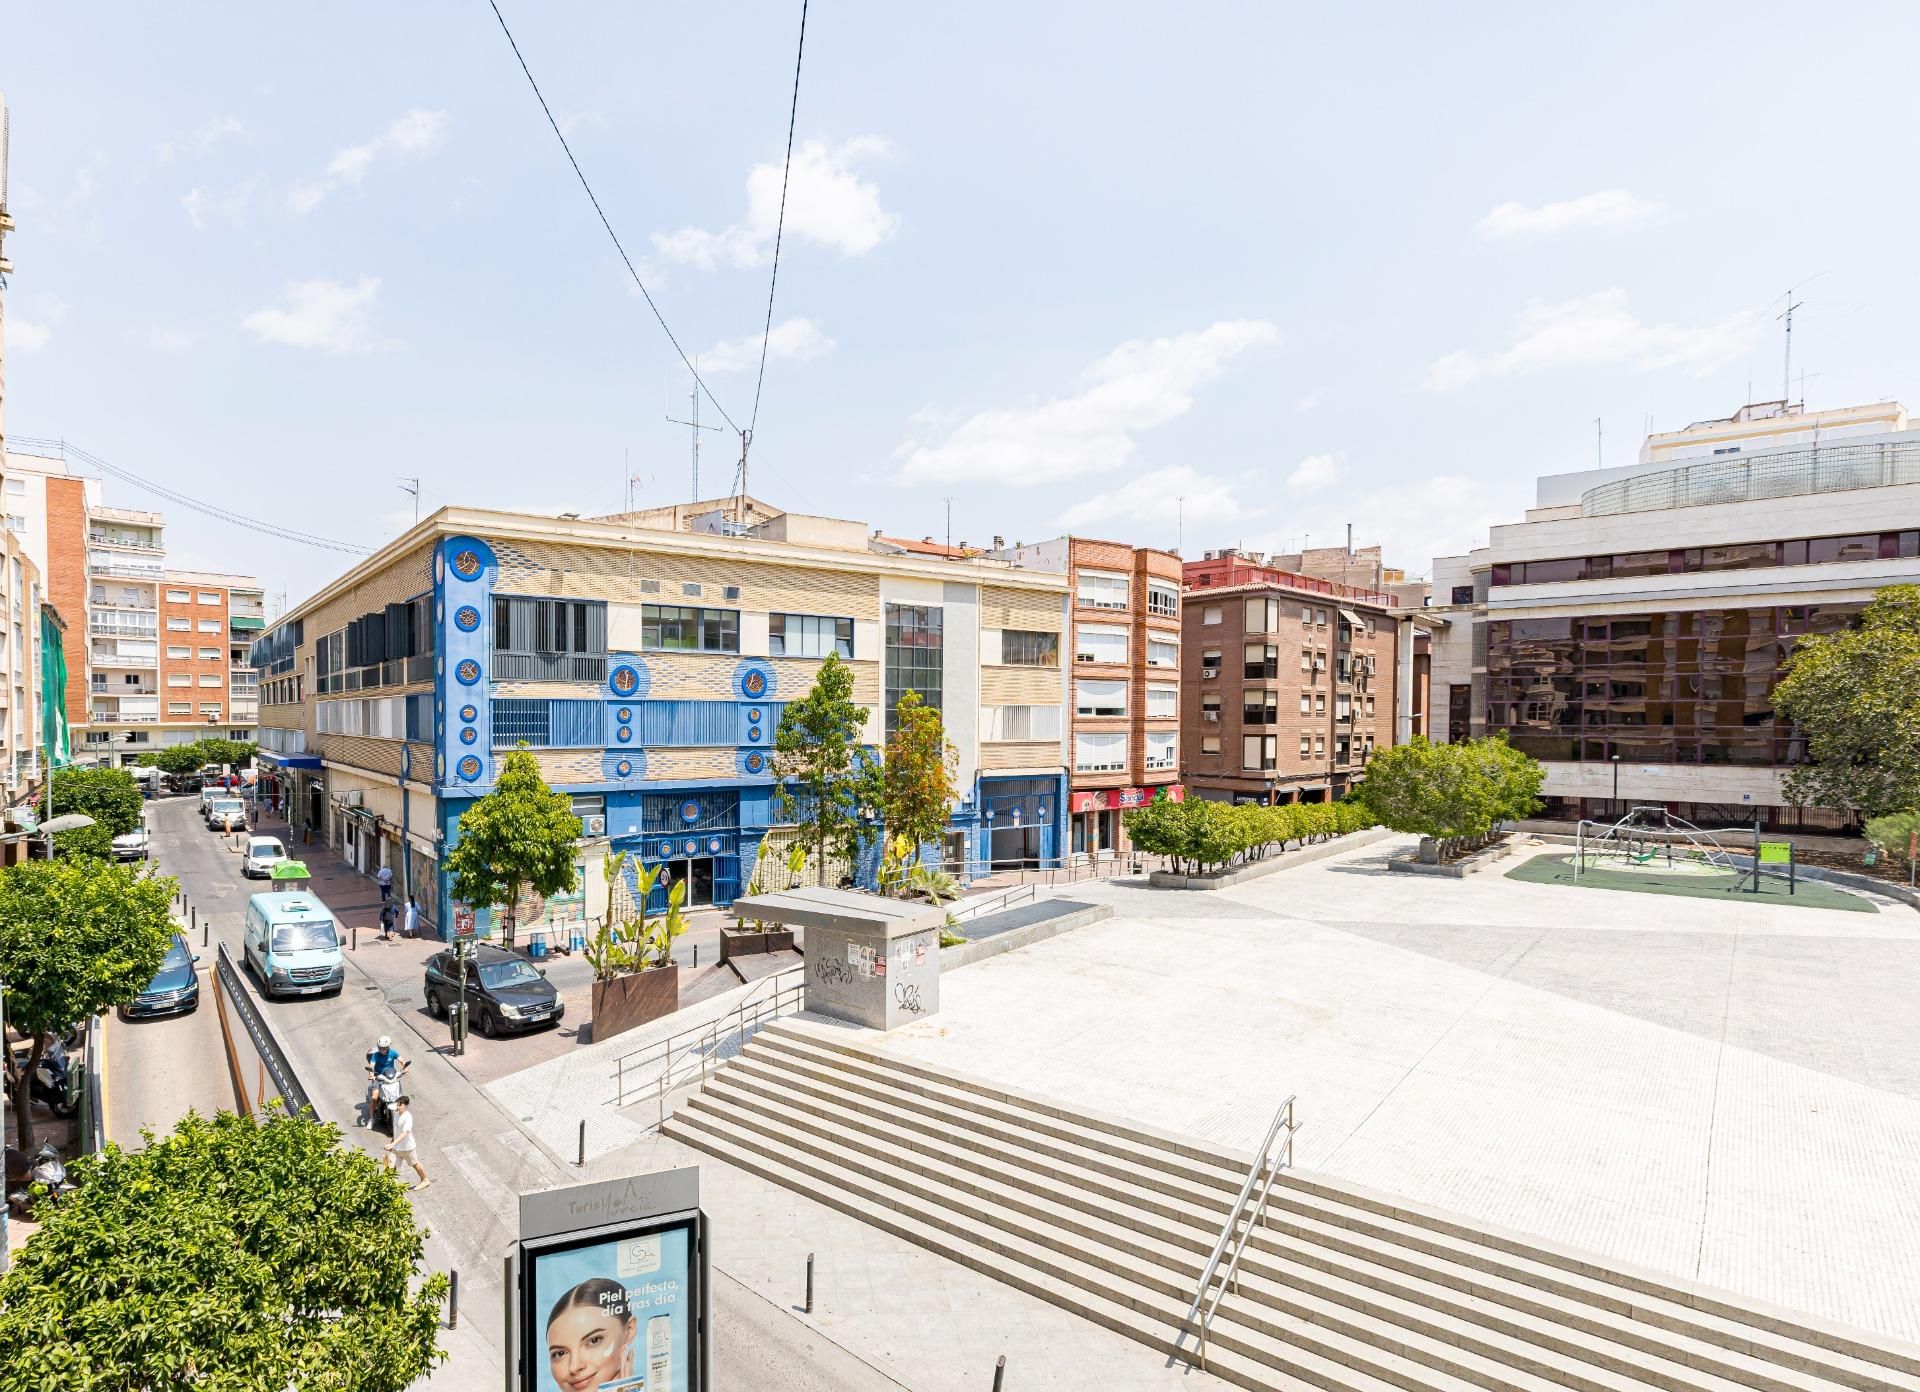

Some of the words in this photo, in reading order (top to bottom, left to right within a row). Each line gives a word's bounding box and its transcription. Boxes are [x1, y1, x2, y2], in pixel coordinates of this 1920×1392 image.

[599, 1288, 622, 1305] Piel
[625, 1280, 679, 1302] perfecta,
[601, 1303, 624, 1317] día
[627, 1299, 650, 1312] tras
